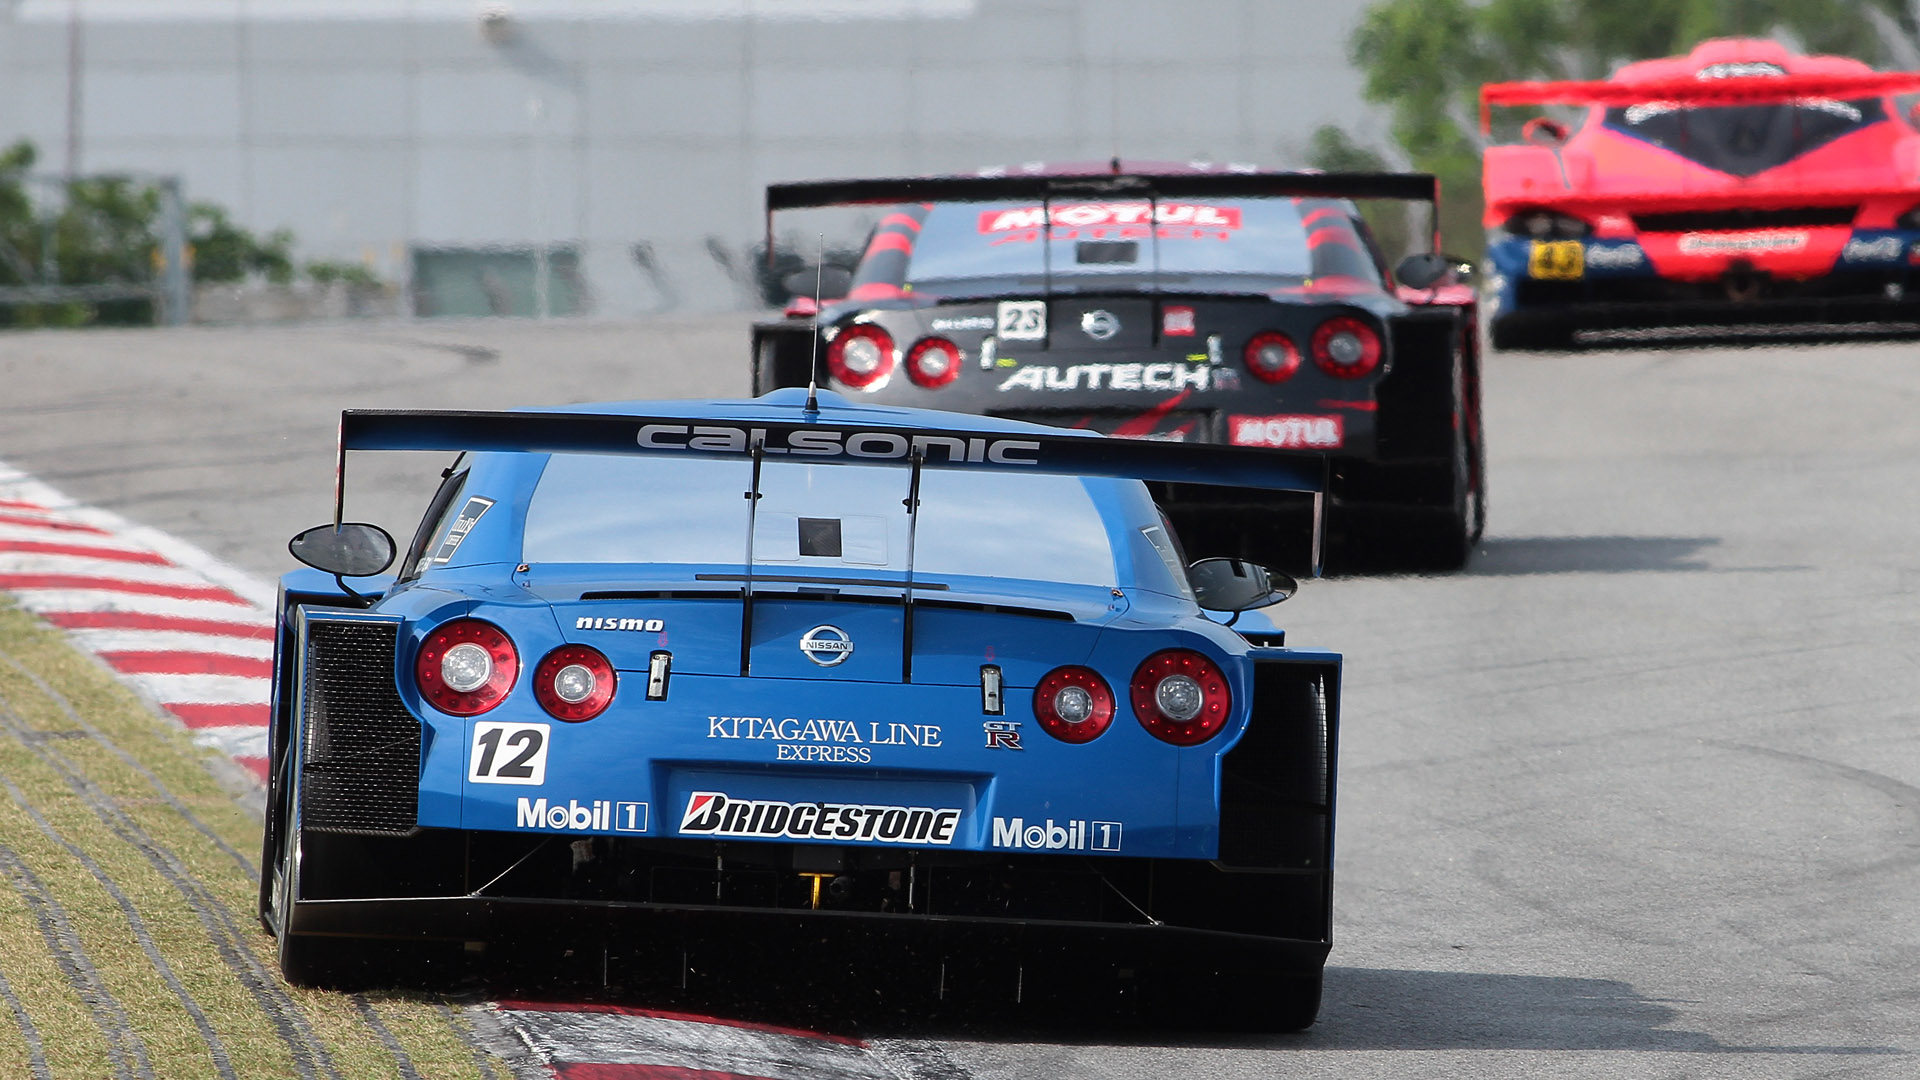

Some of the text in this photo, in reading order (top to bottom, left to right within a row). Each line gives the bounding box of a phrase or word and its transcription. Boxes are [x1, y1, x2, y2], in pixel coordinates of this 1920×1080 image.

[990, 204, 1229, 232] MOTUL
[1002, 307, 1040, 332] 23
[997, 364, 1211, 392] AUTECH
[1236, 417, 1341, 447] MOTUL
[576, 617, 664, 632] nismo
[806, 641, 848, 650] NISSAN
[707, 716, 943, 747] KITAGAWA LINE
[983, 721, 1022, 731] GT
[984, 729, 1024, 750] R
[476, 728, 543, 778] 12
[776, 744, 872, 764] EXPRESS
[516, 797, 611, 831] Mobil
[682, 795, 958, 841] BRIDGESTONE
[992, 817, 1086, 850] Mobil
